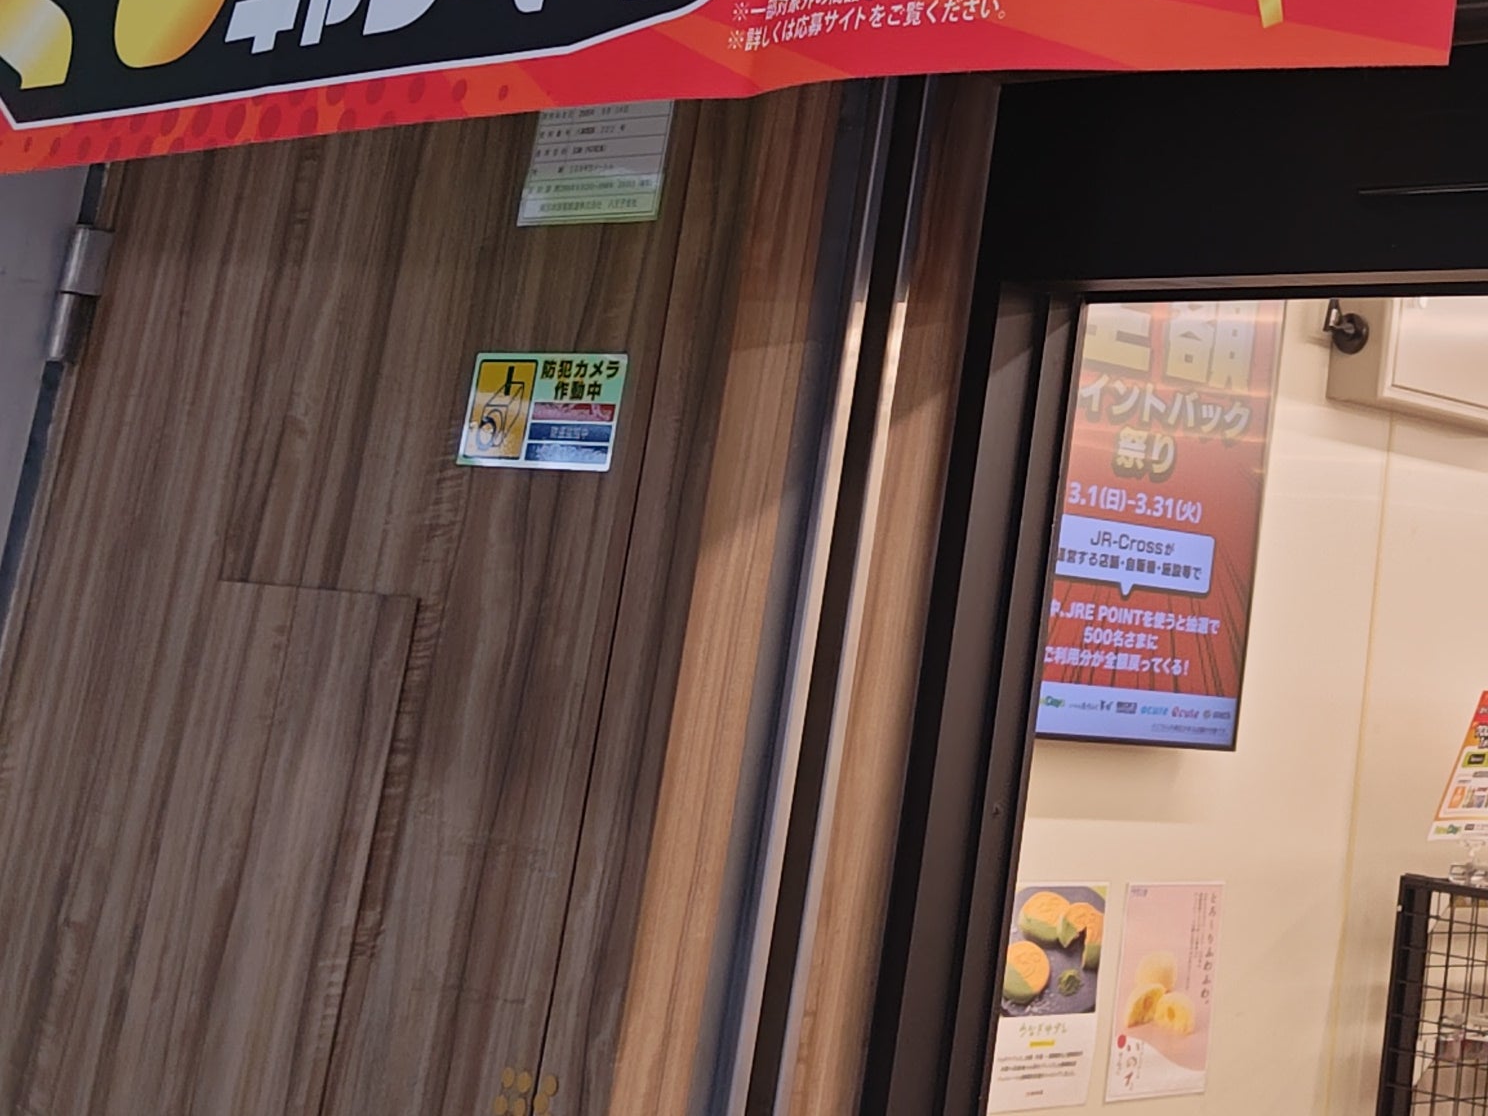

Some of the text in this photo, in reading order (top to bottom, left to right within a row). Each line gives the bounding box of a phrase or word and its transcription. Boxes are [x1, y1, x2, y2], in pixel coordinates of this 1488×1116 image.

[540, 360, 620, 380] 防犯カメラ
[554, 381, 602, 401] 作動中
[1116, 426, 1176, 475] 祭り
[1090, 530, 1176, 557] JR-Crossが
[1083, 626, 1159, 651] 500名さまに
